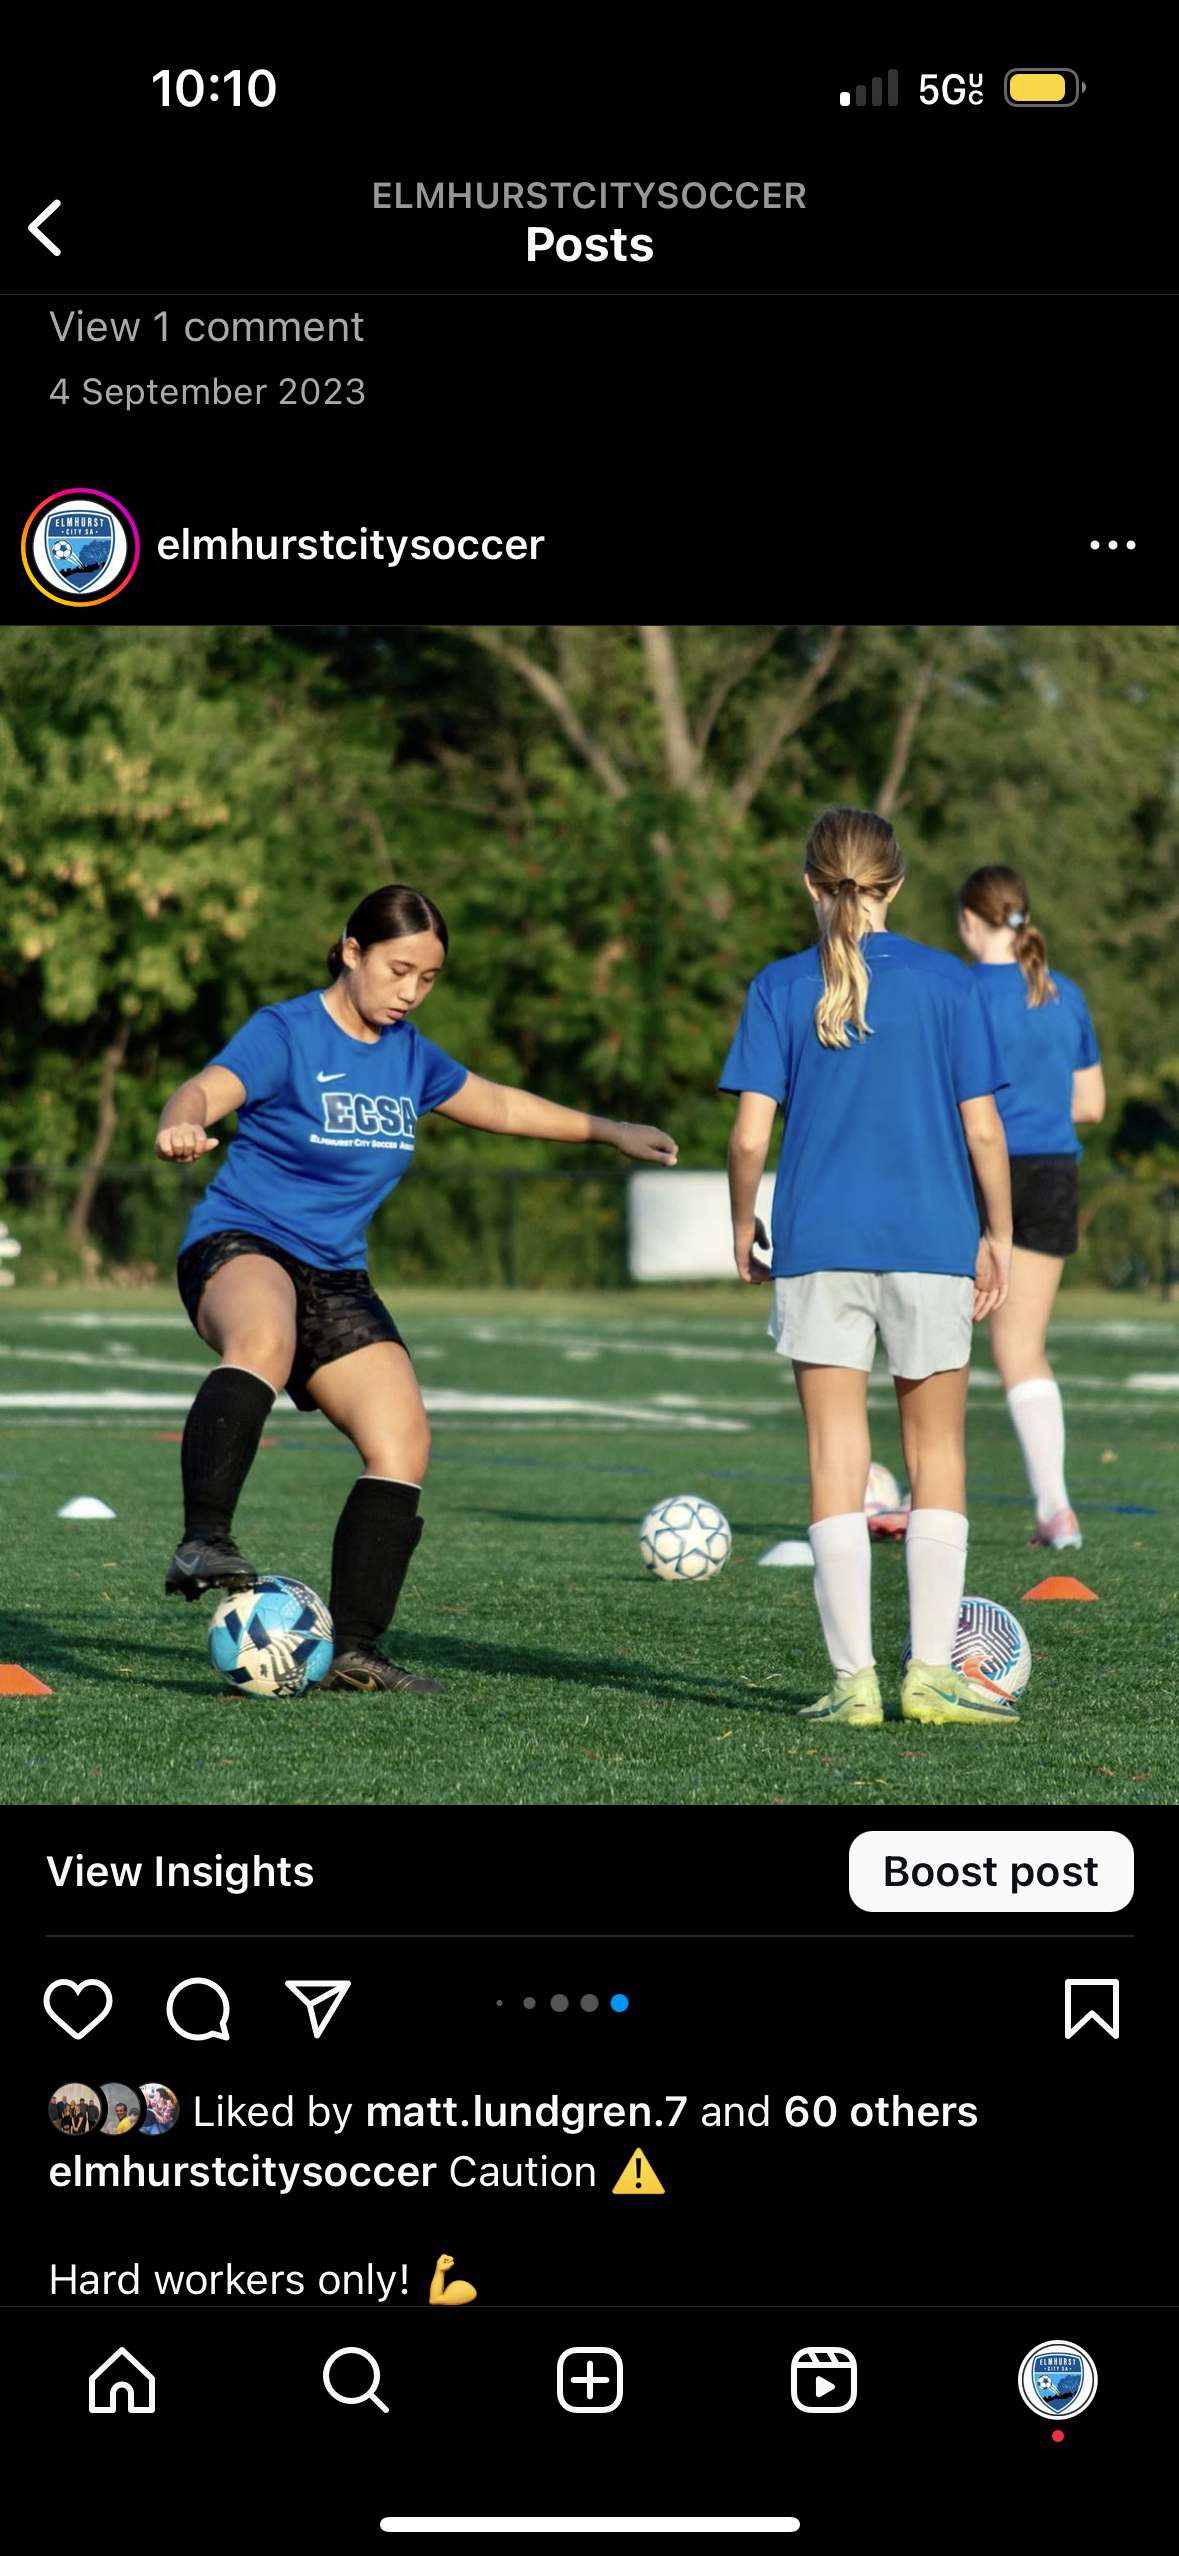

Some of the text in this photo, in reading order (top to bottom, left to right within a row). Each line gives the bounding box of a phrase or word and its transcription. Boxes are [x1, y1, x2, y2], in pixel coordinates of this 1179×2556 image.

[153, 69, 276, 107] 10:10
[374, 182, 806, 209] ELMHURSTCITYSOCCER
[528, 227, 653, 262] Posts
[50, 310, 363, 342] View 1 comment
[50, 377, 364, 410] 4 September 2023
[55, 517, 104, 527] ELMHURST
[158, 527, 545, 567] elmhurstcitysoccer
[322, 1092, 417, 1138] ECSA
[46, 1854, 313, 1894] View Insights
[885, 1856, 1098, 1894] Boost post
[196, 2095, 977, 2134] Liked by matt.lundgren.7 and 60 others
[50, 2154, 595, 2194] elmhurstcitysoccer Caution
[52, 2263, 409, 2303] Hard workers only!
